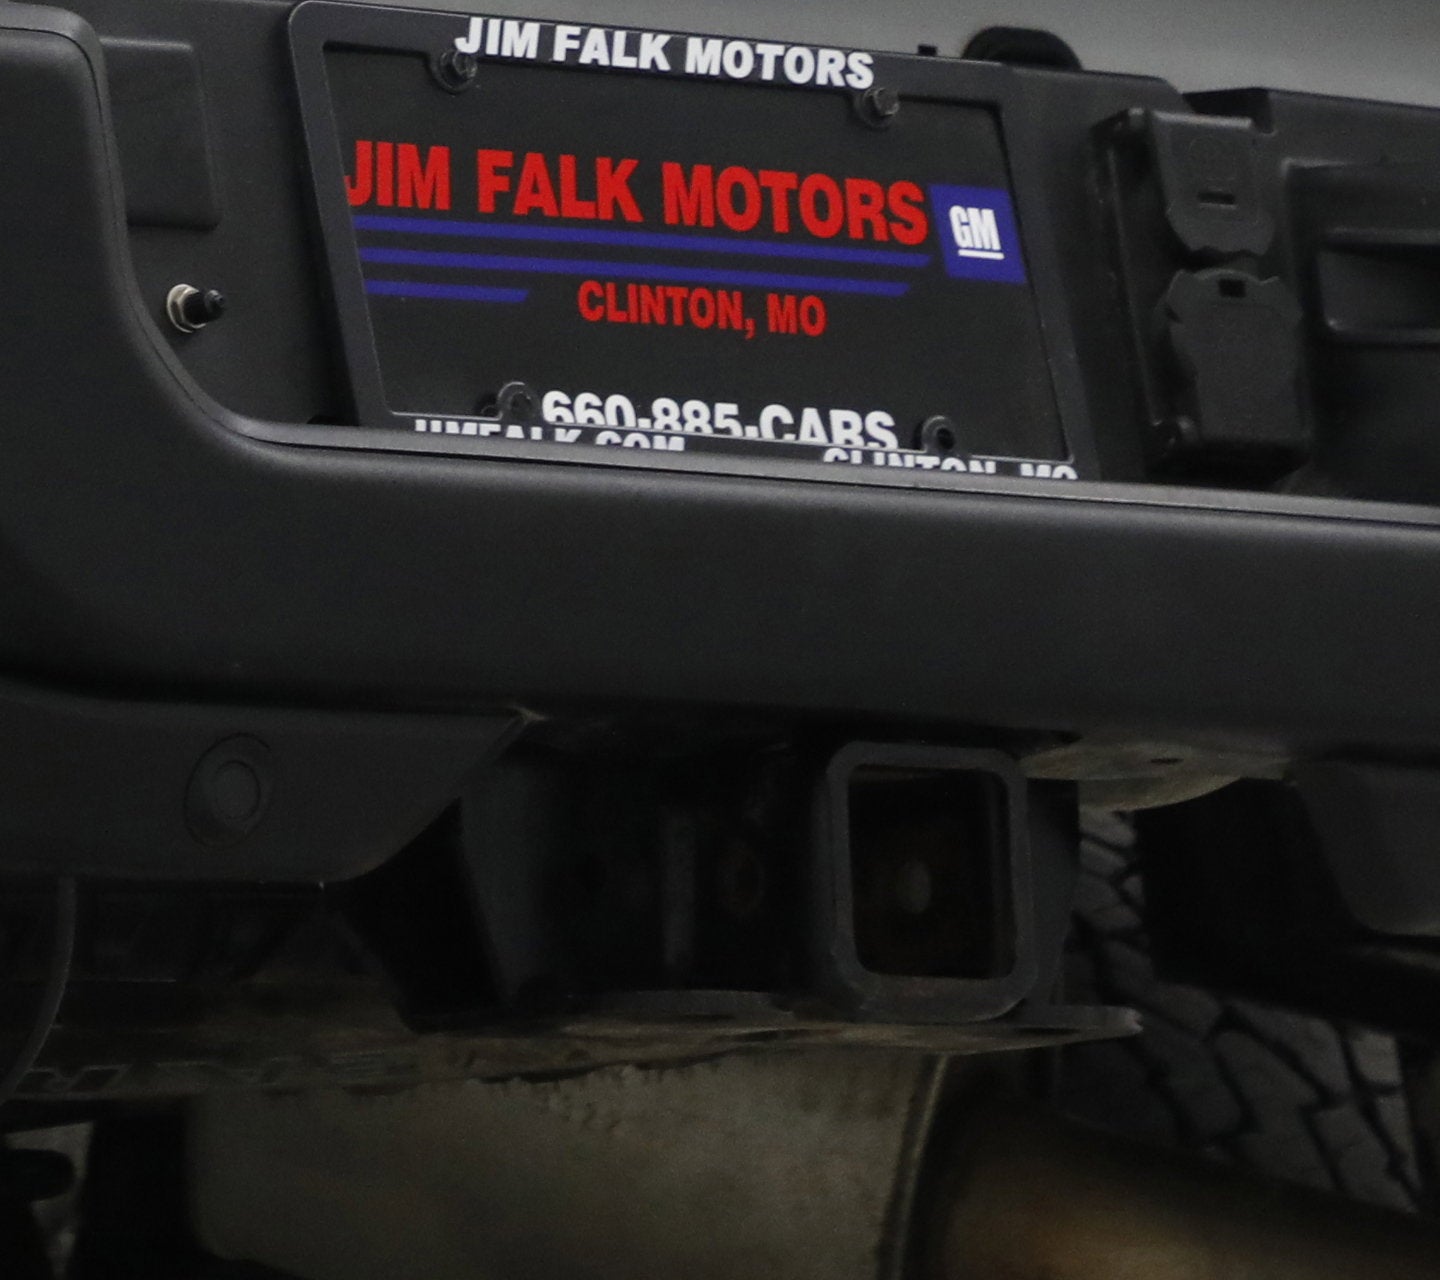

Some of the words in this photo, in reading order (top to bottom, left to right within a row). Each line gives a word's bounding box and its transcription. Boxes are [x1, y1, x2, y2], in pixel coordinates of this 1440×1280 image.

[454, 16, 541, 59] JIM
[552, 25, 671, 72] FALK
[684, 36, 875, 90] MOTORS
[344, 139, 451, 210] JIM
[476, 148, 643, 223] FALK
[661, 161, 929, 246] MOTORS
[948, 204, 1001, 251] GM
[577, 279, 756, 339] CLINTON,
[766, 292, 828, 336] MO
[541, 390, 899, 450] 660-885-CARS
